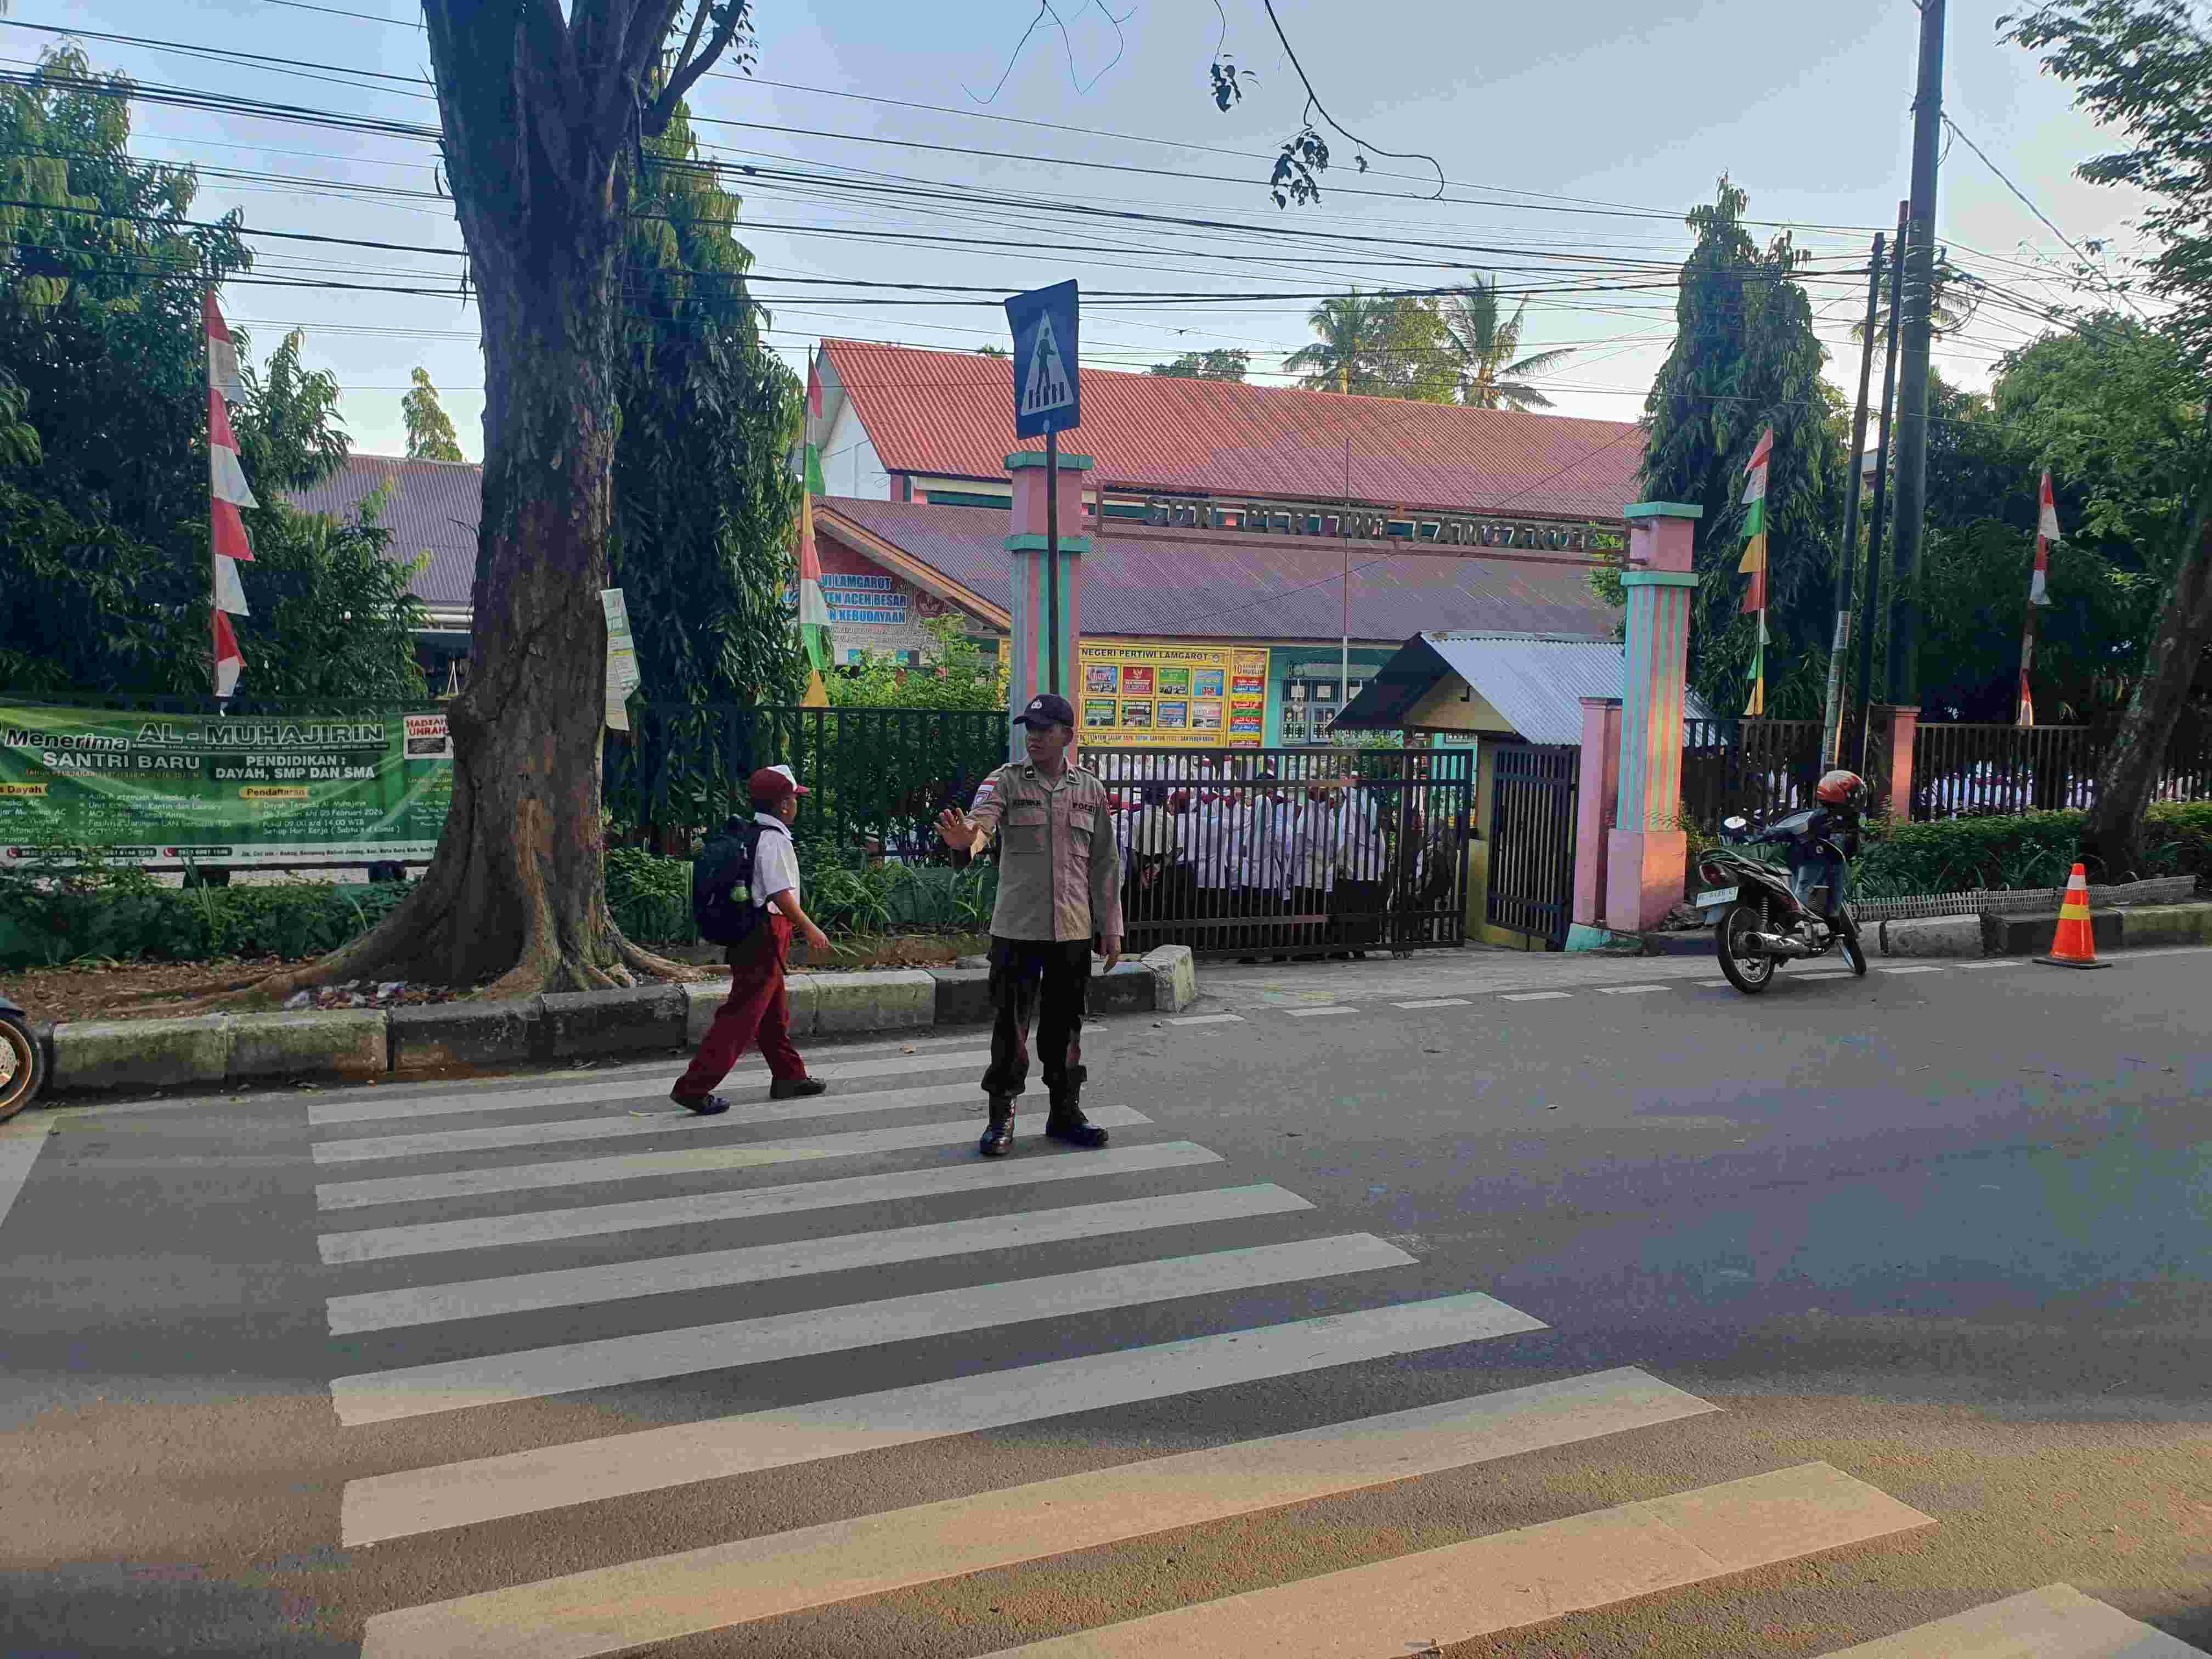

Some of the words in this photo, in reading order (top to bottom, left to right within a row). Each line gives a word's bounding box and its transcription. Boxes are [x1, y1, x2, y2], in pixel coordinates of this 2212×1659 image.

[1144, 496, 1212, 528] SDN
[1244, 501, 1387, 540] PERTIWI
[1412, 517, 1596, 550] LAMGAROT
[834, 574, 891, 591] LAMGAROT
[843, 591, 873, 606] ACEH
[873, 593, 907, 608] BESAR
[839, 609, 906, 624] KEBUDAYAAN
[1119, 650, 1156, 658] PERTIWI
[1159, 651, 1208, 660] LAMGAROT
[4, 727, 129, 752] Menerima
[137, 723, 183, 744] AL
[205, 723, 384, 745] MUHAJIRIN
[43, 751, 129, 768] SANTRI
[138, 755, 200, 770] BARU
[246, 755, 336, 766] PENDIDIKAN
[216, 768, 269, 780] DAYAH,
[274, 768, 306, 778] SMP
[310, 767, 339, 778] DAN
[344, 767, 375, 778] SMA
[247, 788, 305, 797] Pendaftaran
